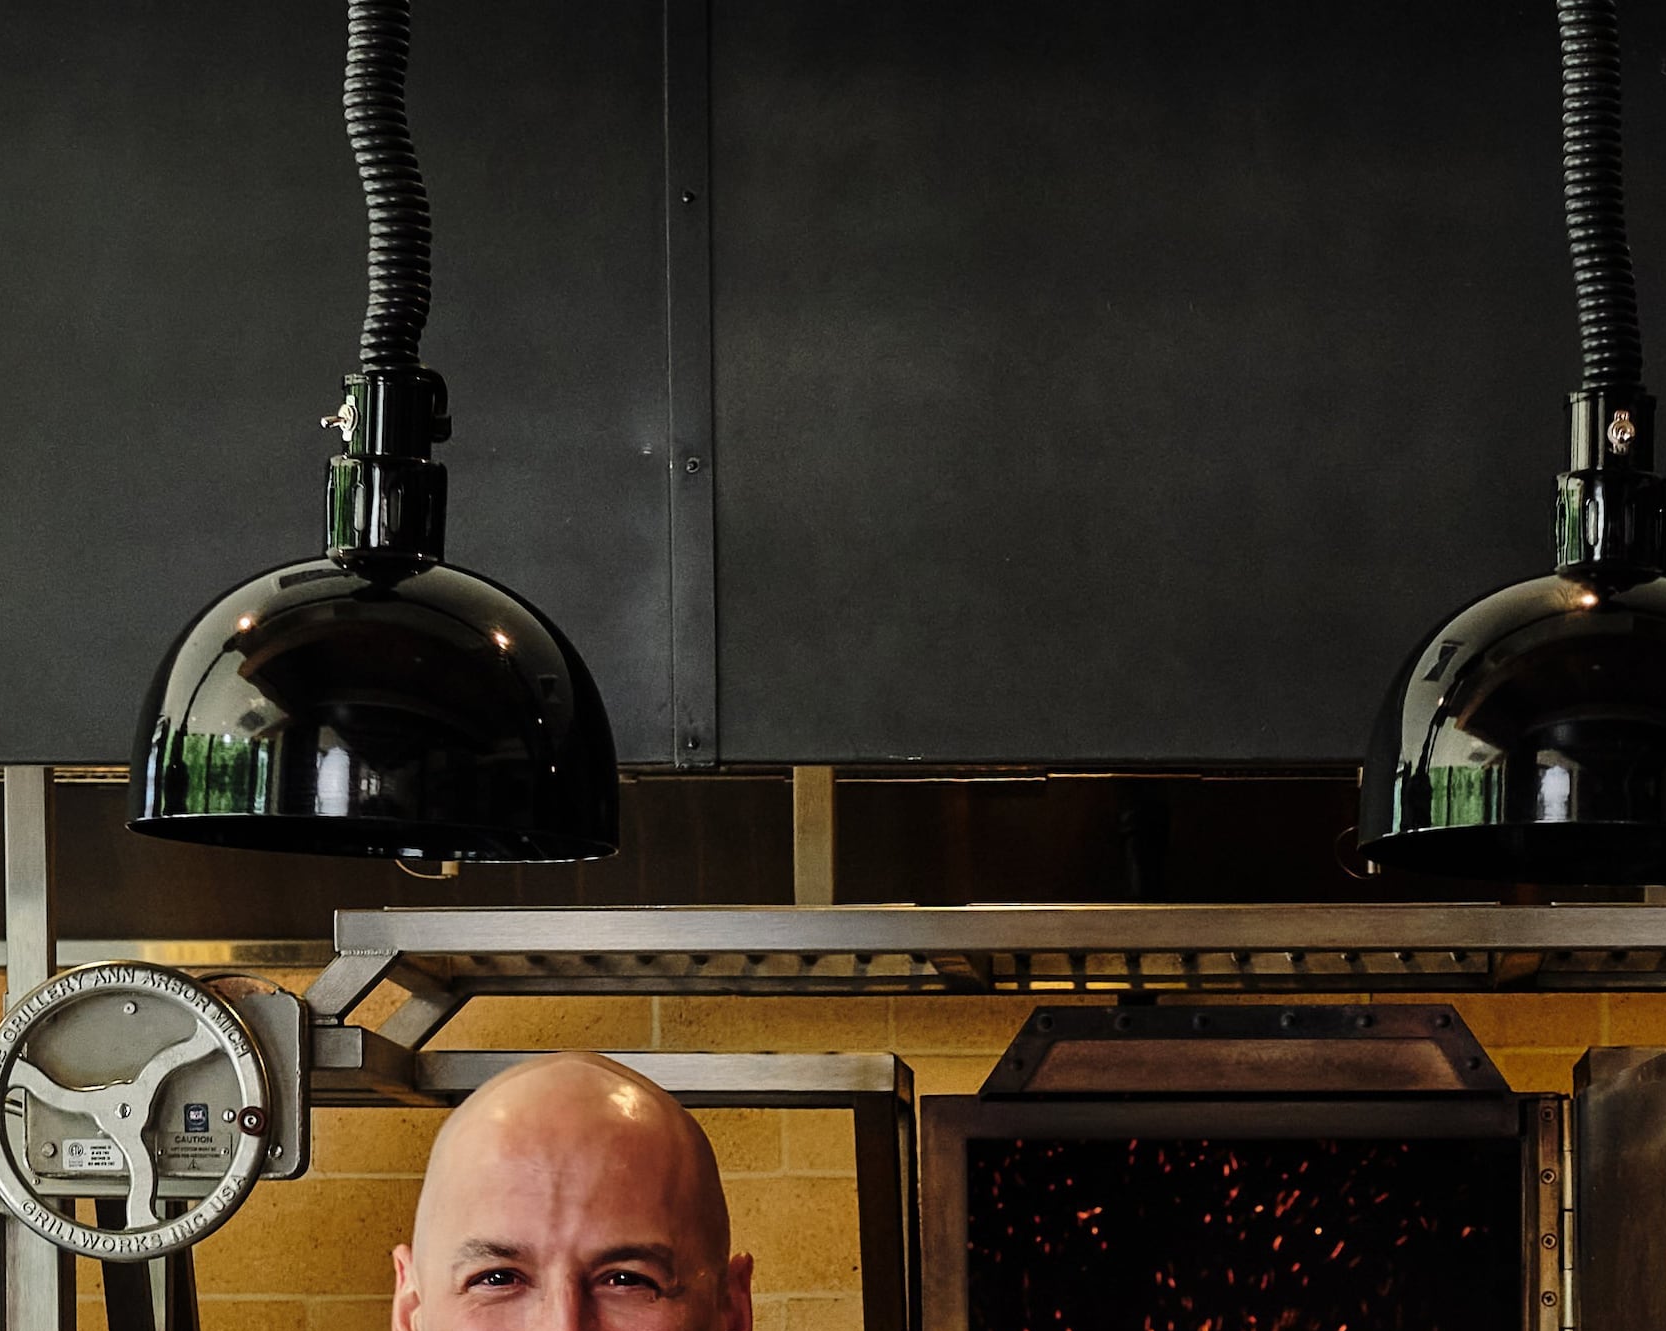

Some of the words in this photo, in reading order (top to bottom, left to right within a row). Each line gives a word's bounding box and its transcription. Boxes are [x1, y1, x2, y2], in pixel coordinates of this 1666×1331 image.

[3, 972, 84, 1043] GRILLERY
[93, 966, 135, 987] ANN
[141, 969, 211, 1013] ARBOR
[212, 1009, 250, 1058] MICH
[174, 1135, 213, 1143] CAUTION
[21, 1200, 163, 1253] GRILLWORKS
[172, 1213, 208, 1242] INC
[212, 1175, 247, 1213] USA
